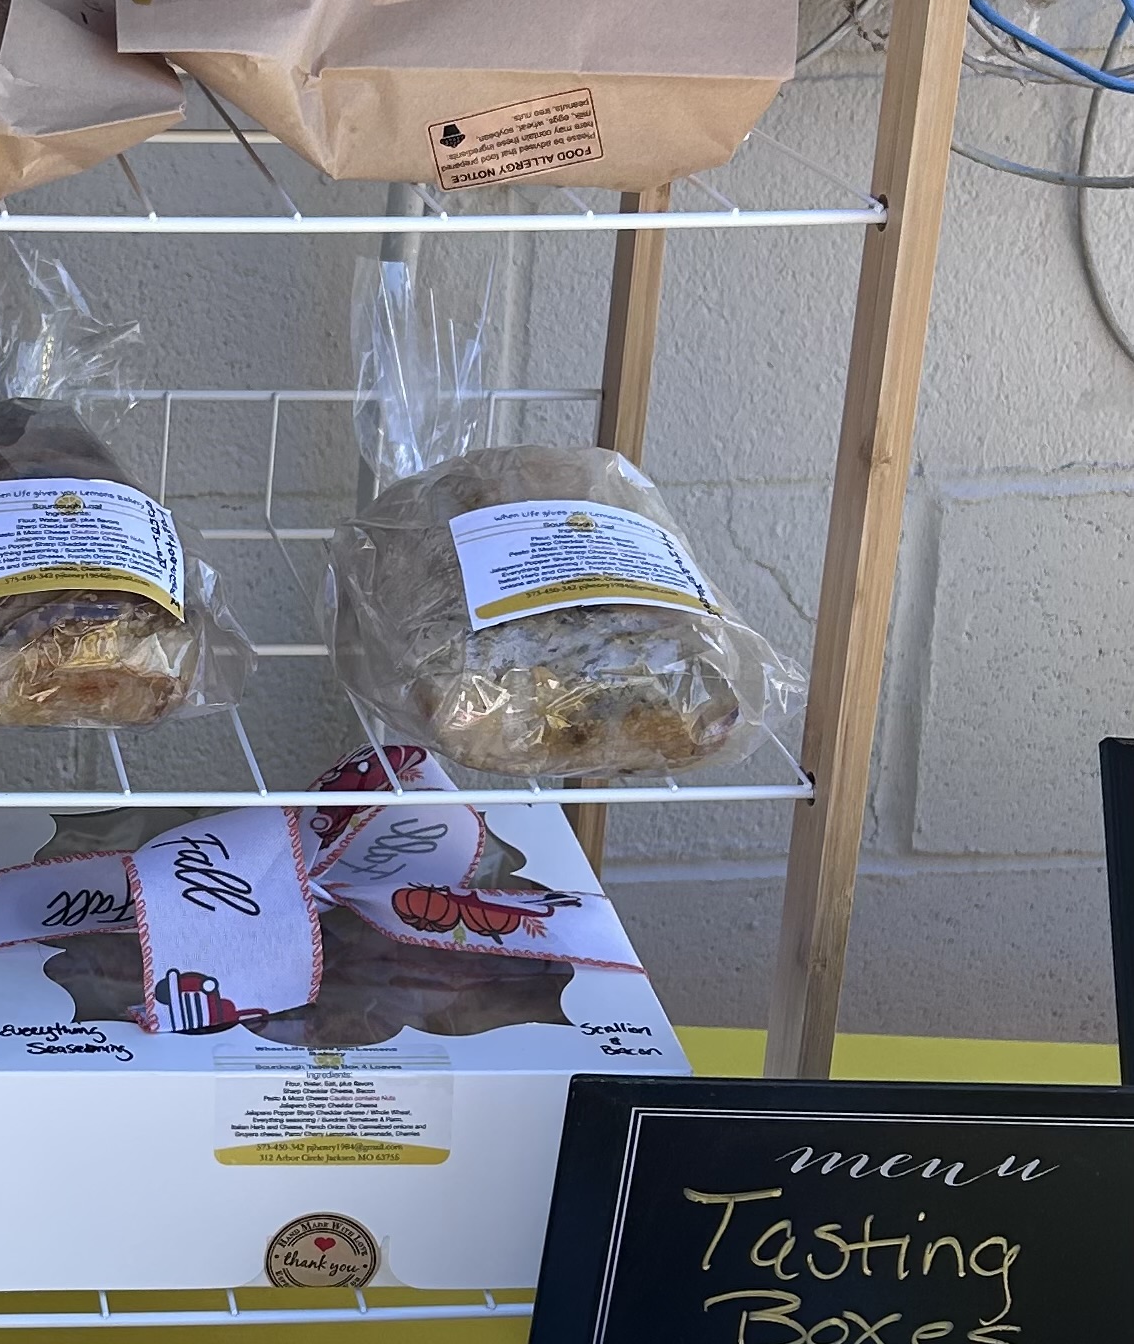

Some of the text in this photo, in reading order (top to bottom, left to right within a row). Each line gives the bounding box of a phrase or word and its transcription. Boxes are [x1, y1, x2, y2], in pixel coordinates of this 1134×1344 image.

[521, 129, 552, 144] contain
[553, 137, 565, 145] be
[554, 125, 573, 135] may
[451, 145, 592, 184] FOOD ALLERGY NOTICE
[151, 832, 261, 917] Fall
[775, 1145, 1060, 1187] menu
[283, 1250, 361, 1277] thank you
[682, 1186, 1022, 1327] Tasting
